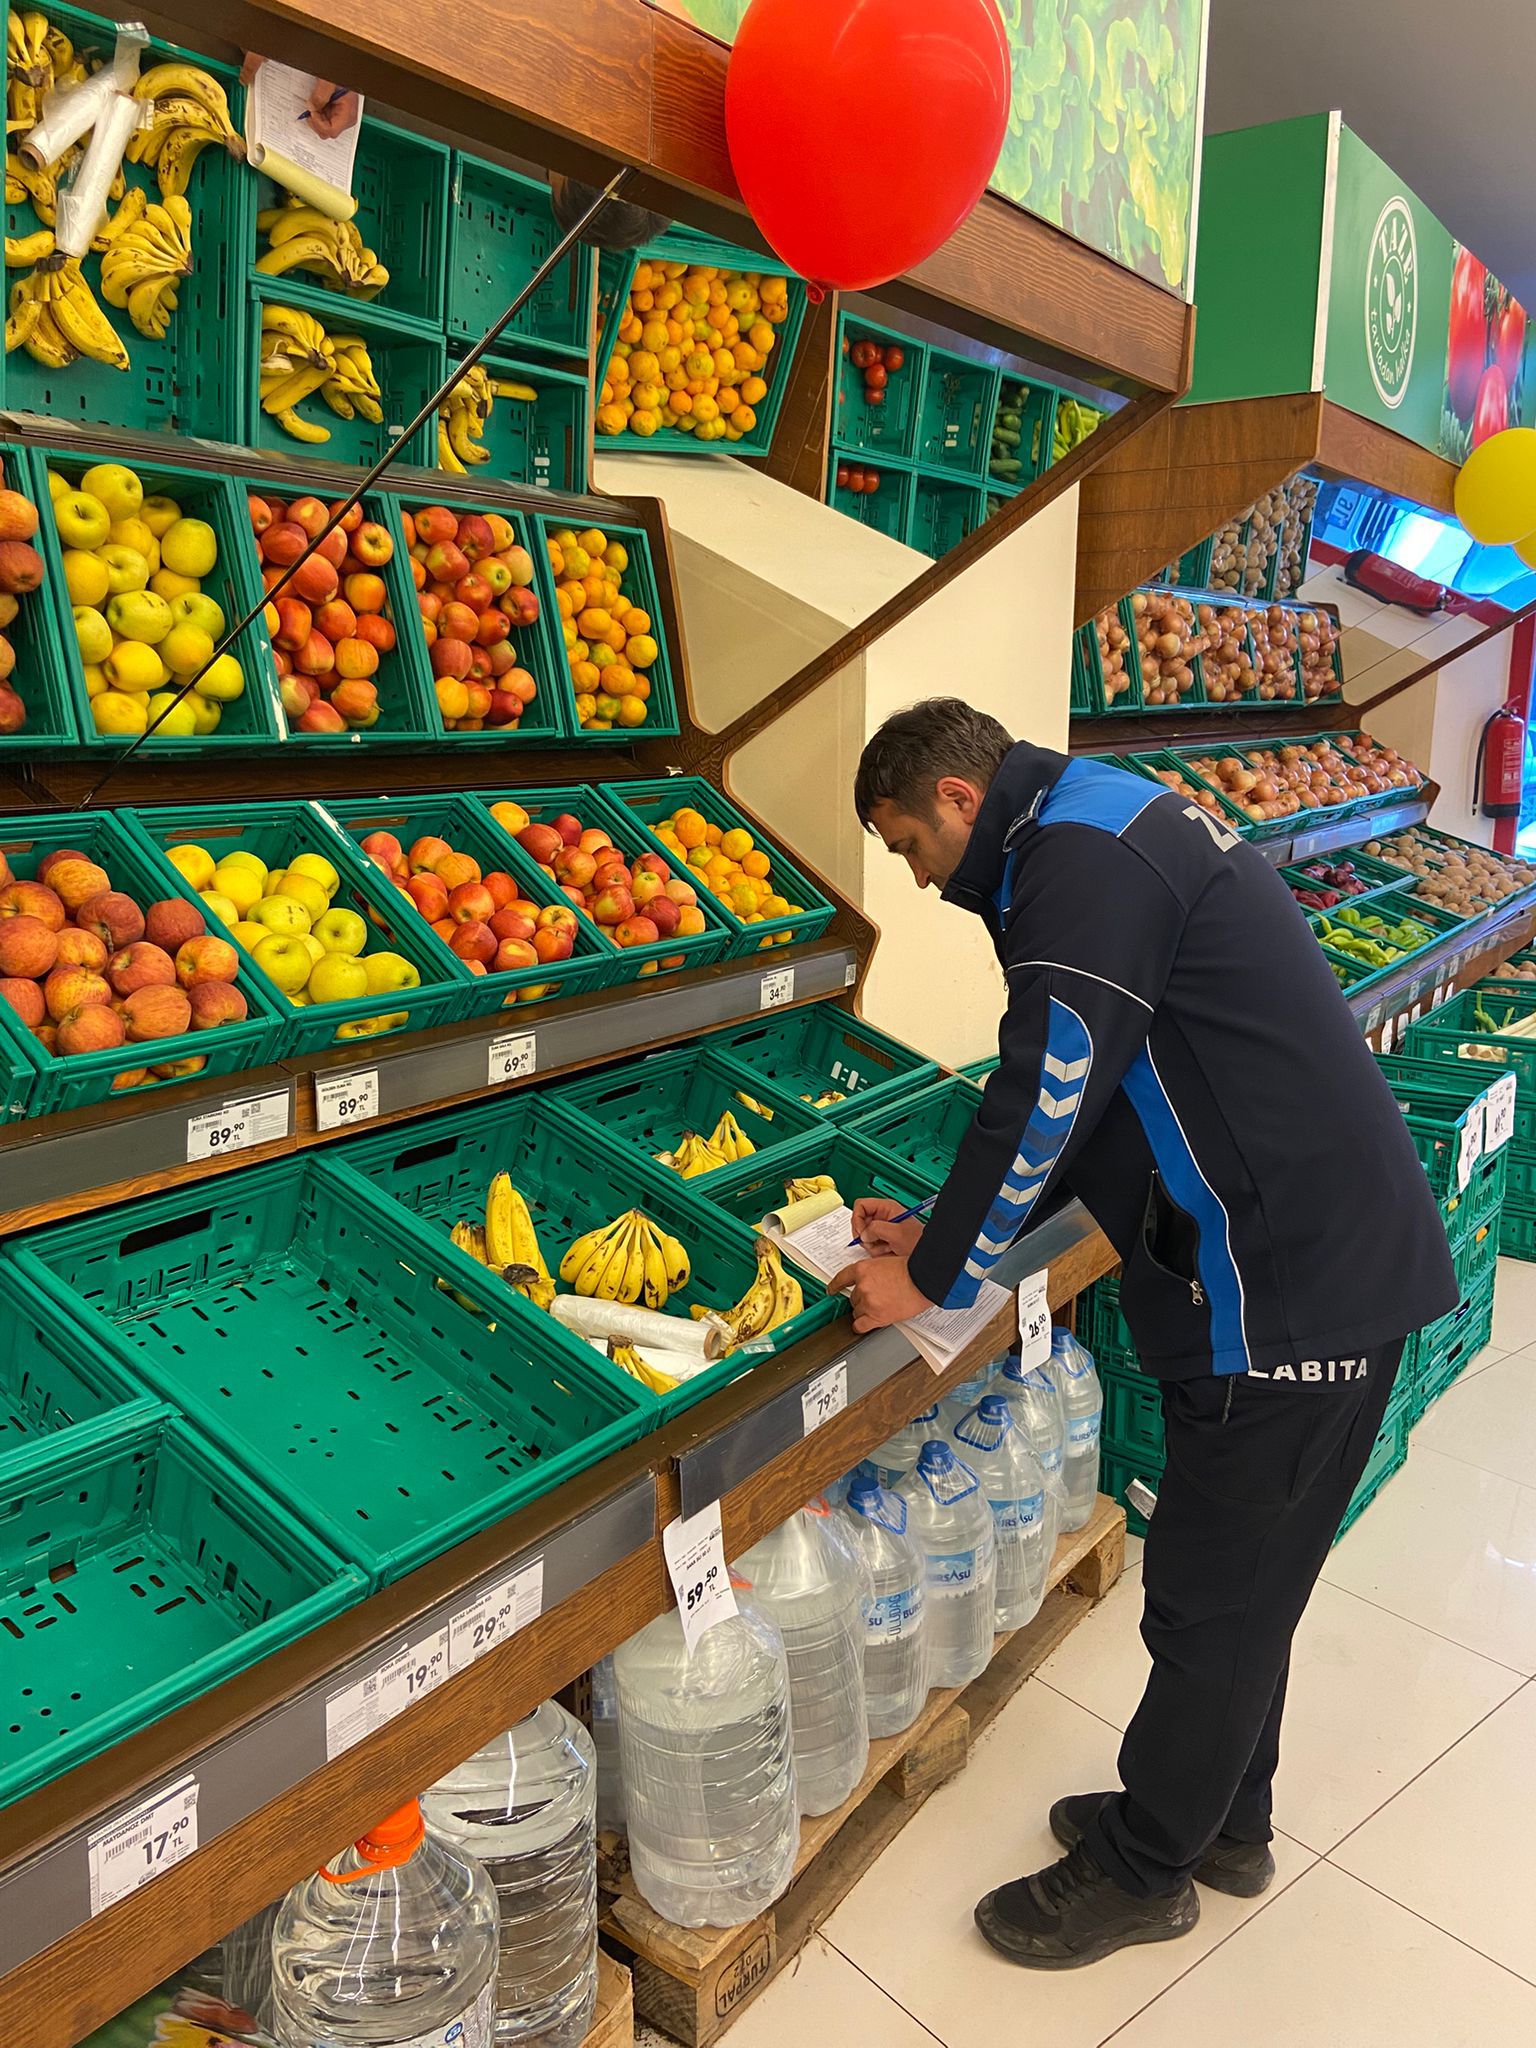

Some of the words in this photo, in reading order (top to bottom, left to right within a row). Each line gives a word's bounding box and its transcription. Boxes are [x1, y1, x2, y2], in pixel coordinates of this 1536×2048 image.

[338, 1093, 369, 1117] 89,90
[209, 1122, 245, 1147] 89,90
[687, 1565, 718, 1610] 59,50
[473, 1604, 511, 1649] 29,90
[406, 1651, 443, 1694] 19,90
[102, 1821, 140, 1847] MAYDANOZ
[140, 1812, 155, 1825] DMT
[142, 1816, 189, 1865] 17,90
[172, 1836, 184, 1848] TL
[718, 1957, 767, 2009] TURPAL
